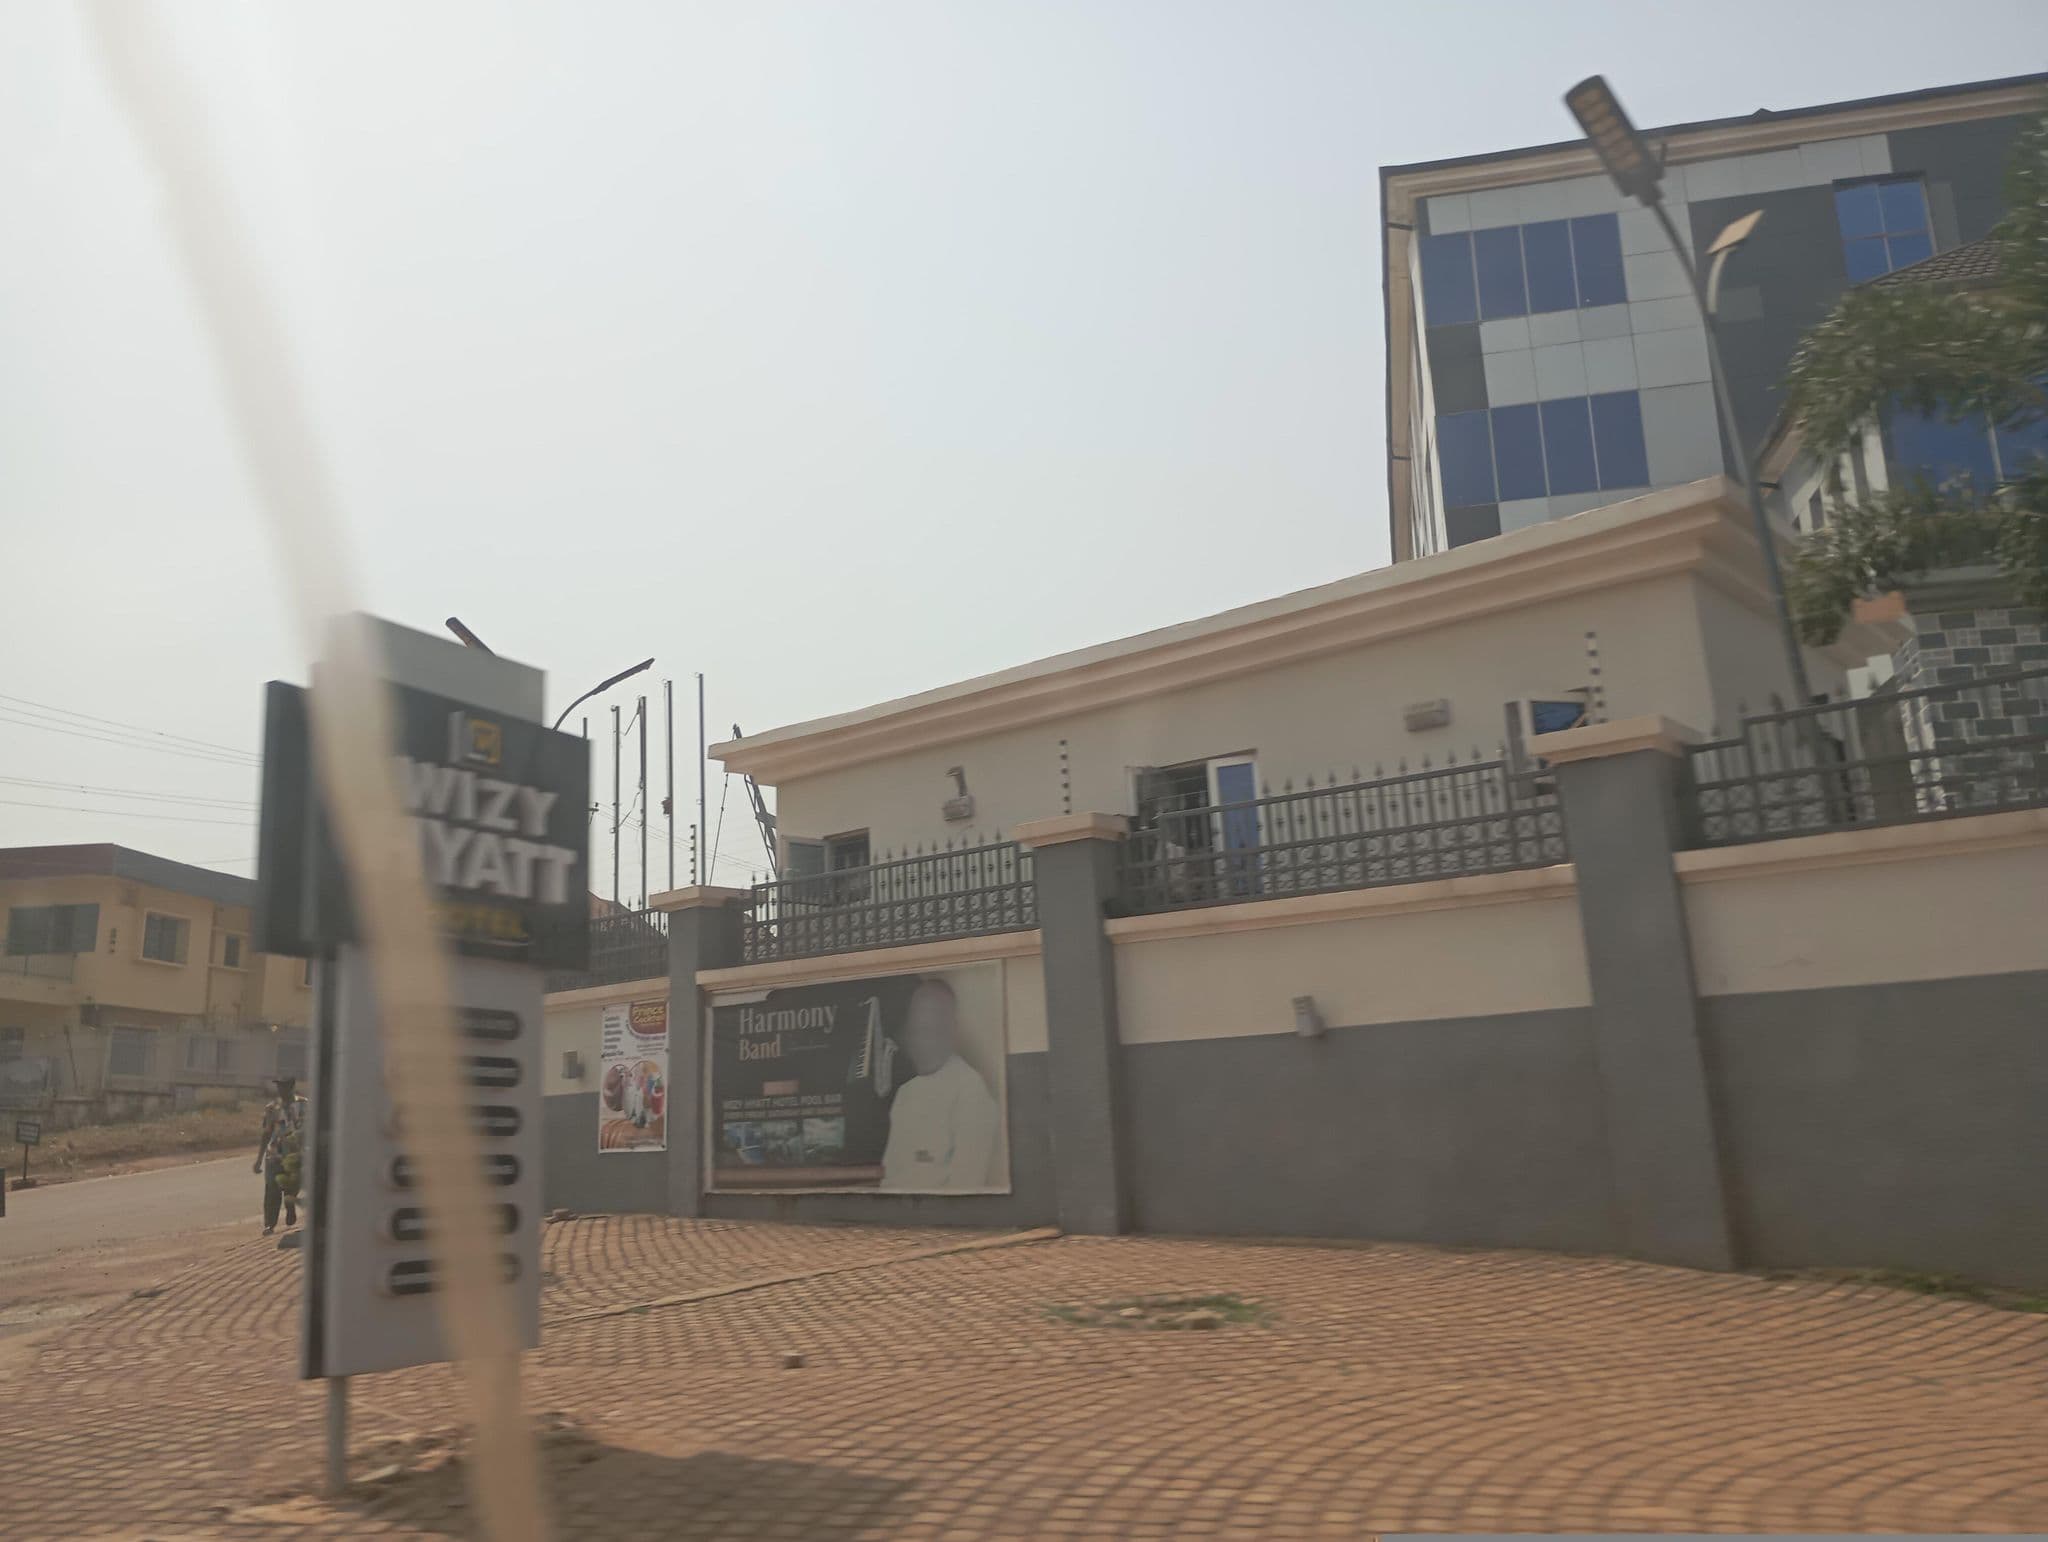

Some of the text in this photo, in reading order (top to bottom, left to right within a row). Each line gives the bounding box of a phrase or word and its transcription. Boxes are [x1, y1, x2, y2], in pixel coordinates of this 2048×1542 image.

[393, 755, 560, 837] WIZY
[412, 816, 578, 904] YATT
[739, 1005, 838, 1034] Harmony
[739, 1033, 781, 1060] Band
